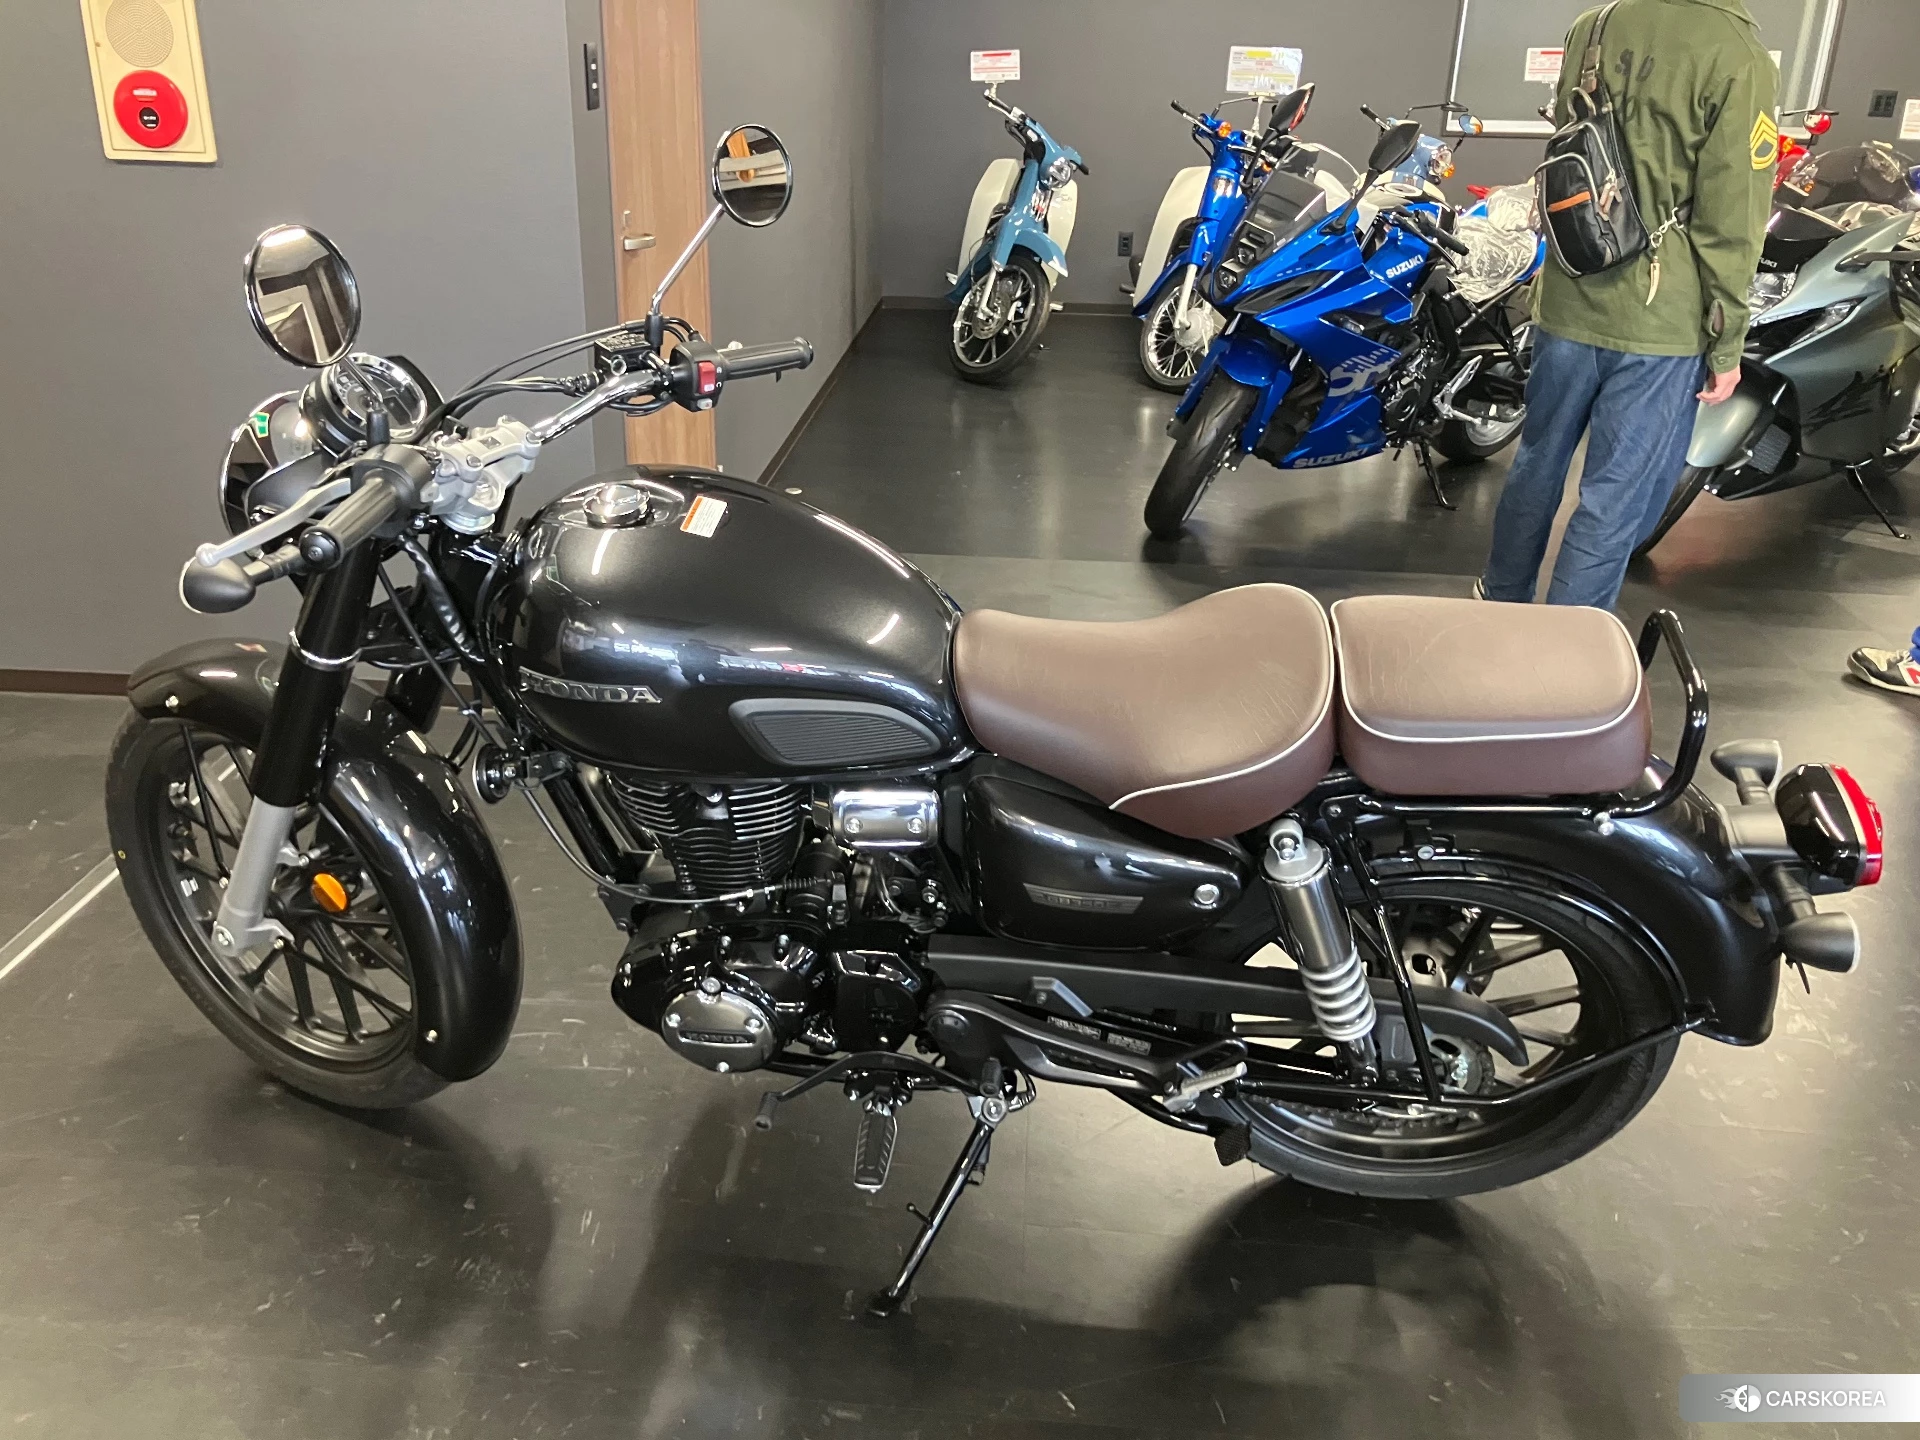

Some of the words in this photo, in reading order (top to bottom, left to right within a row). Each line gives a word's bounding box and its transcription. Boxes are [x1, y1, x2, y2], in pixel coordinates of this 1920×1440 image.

[1385, 254, 1424, 278] SUZUKI
[1293, 447, 1369, 468] SUZUKI
[519, 668, 661, 703] HONDA
